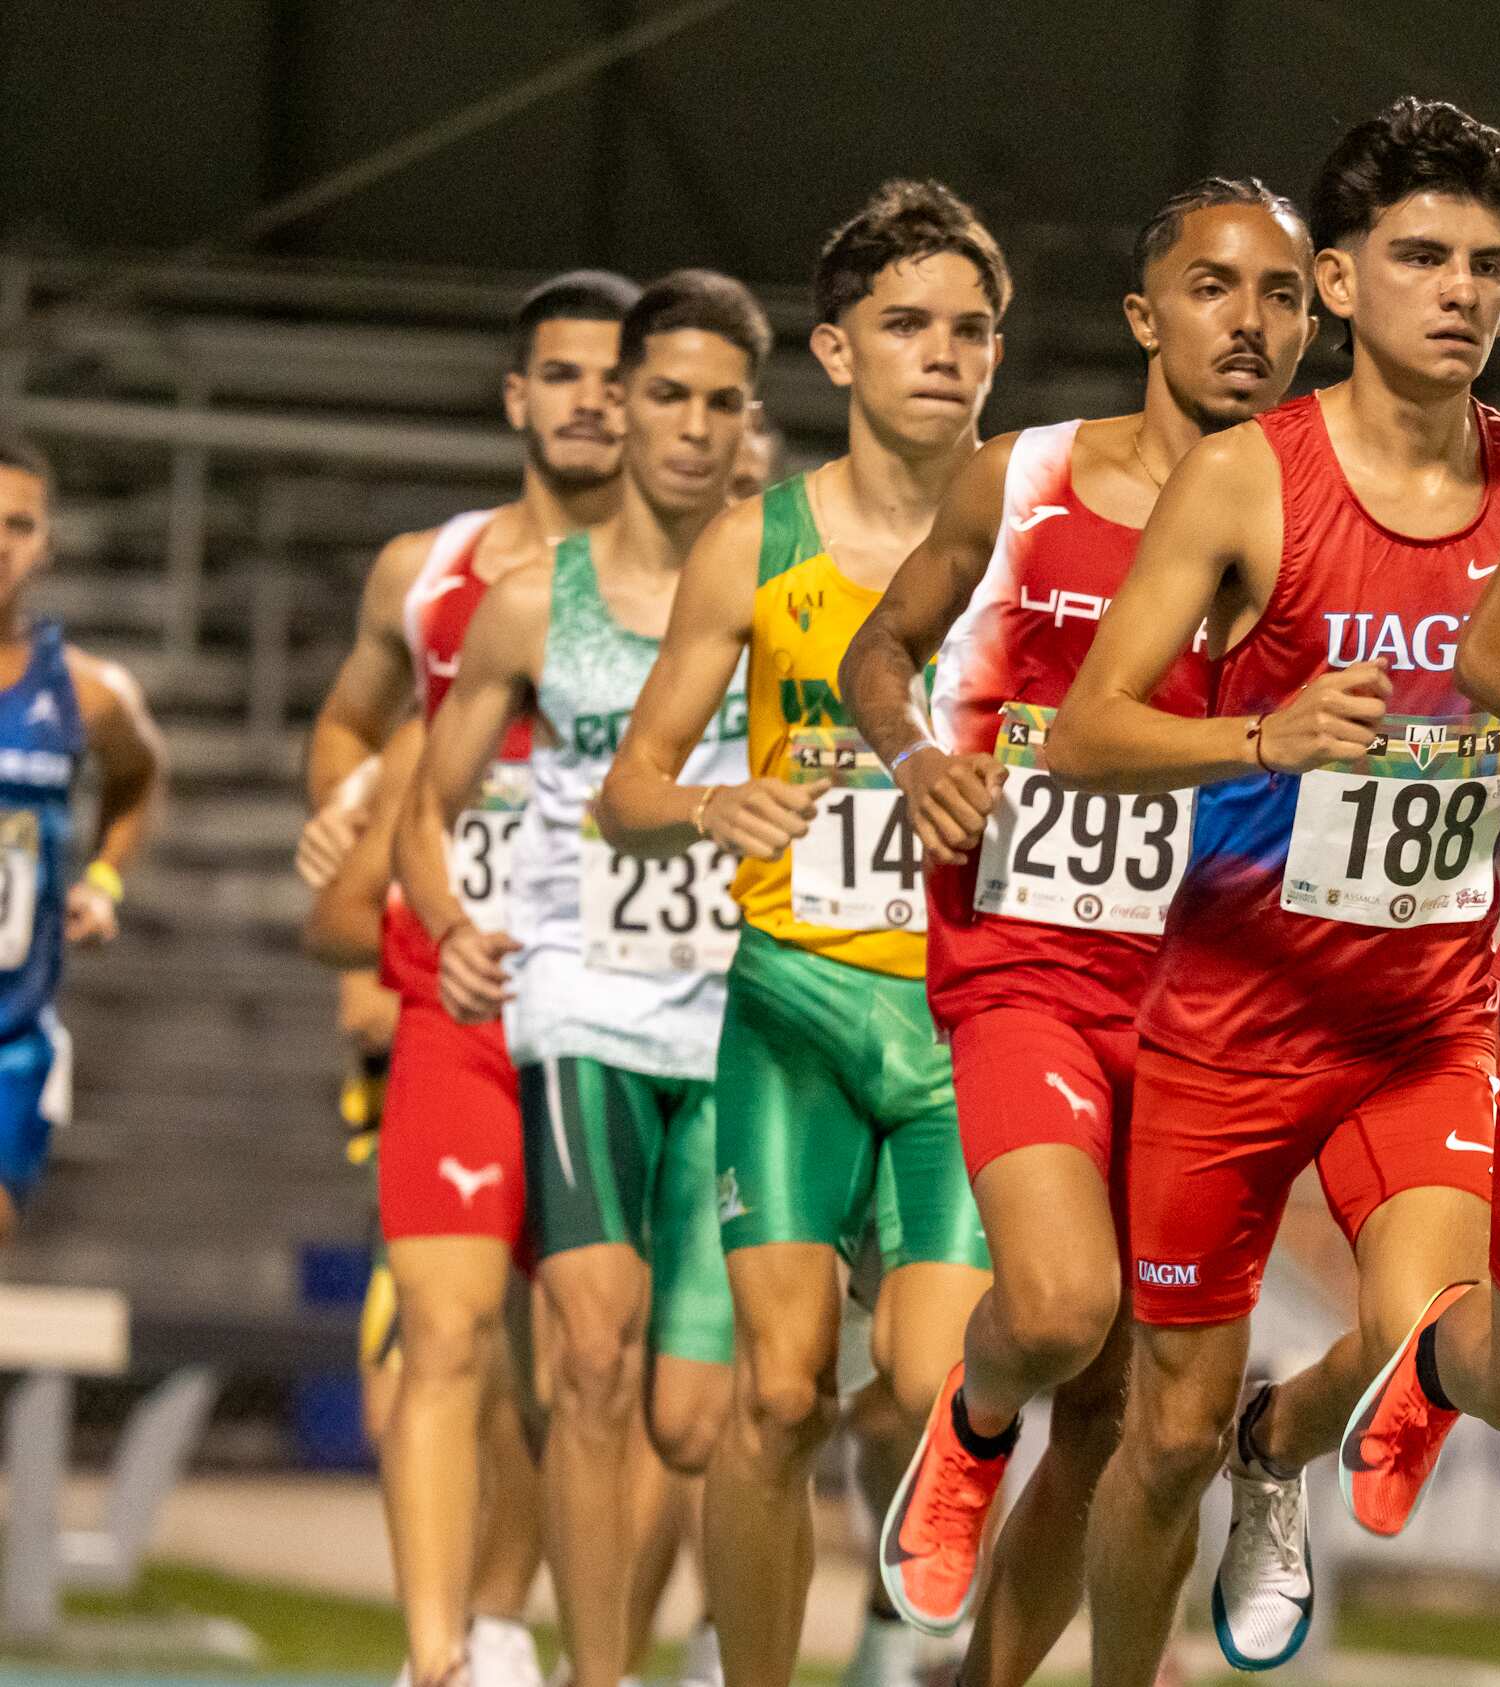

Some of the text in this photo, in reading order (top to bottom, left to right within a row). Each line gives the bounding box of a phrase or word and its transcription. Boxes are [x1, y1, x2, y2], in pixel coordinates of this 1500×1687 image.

[787, 591, 825, 608] LAI
[1323, 612, 1472, 672] UAG
[1408, 727, 1446, 744] LAI
[827, 794, 924, 890] 14
[1012, 773, 1179, 892] 293
[1341, 779, 1488, 887] 188
[1138, 1260, 1198, 1285] UAGM
